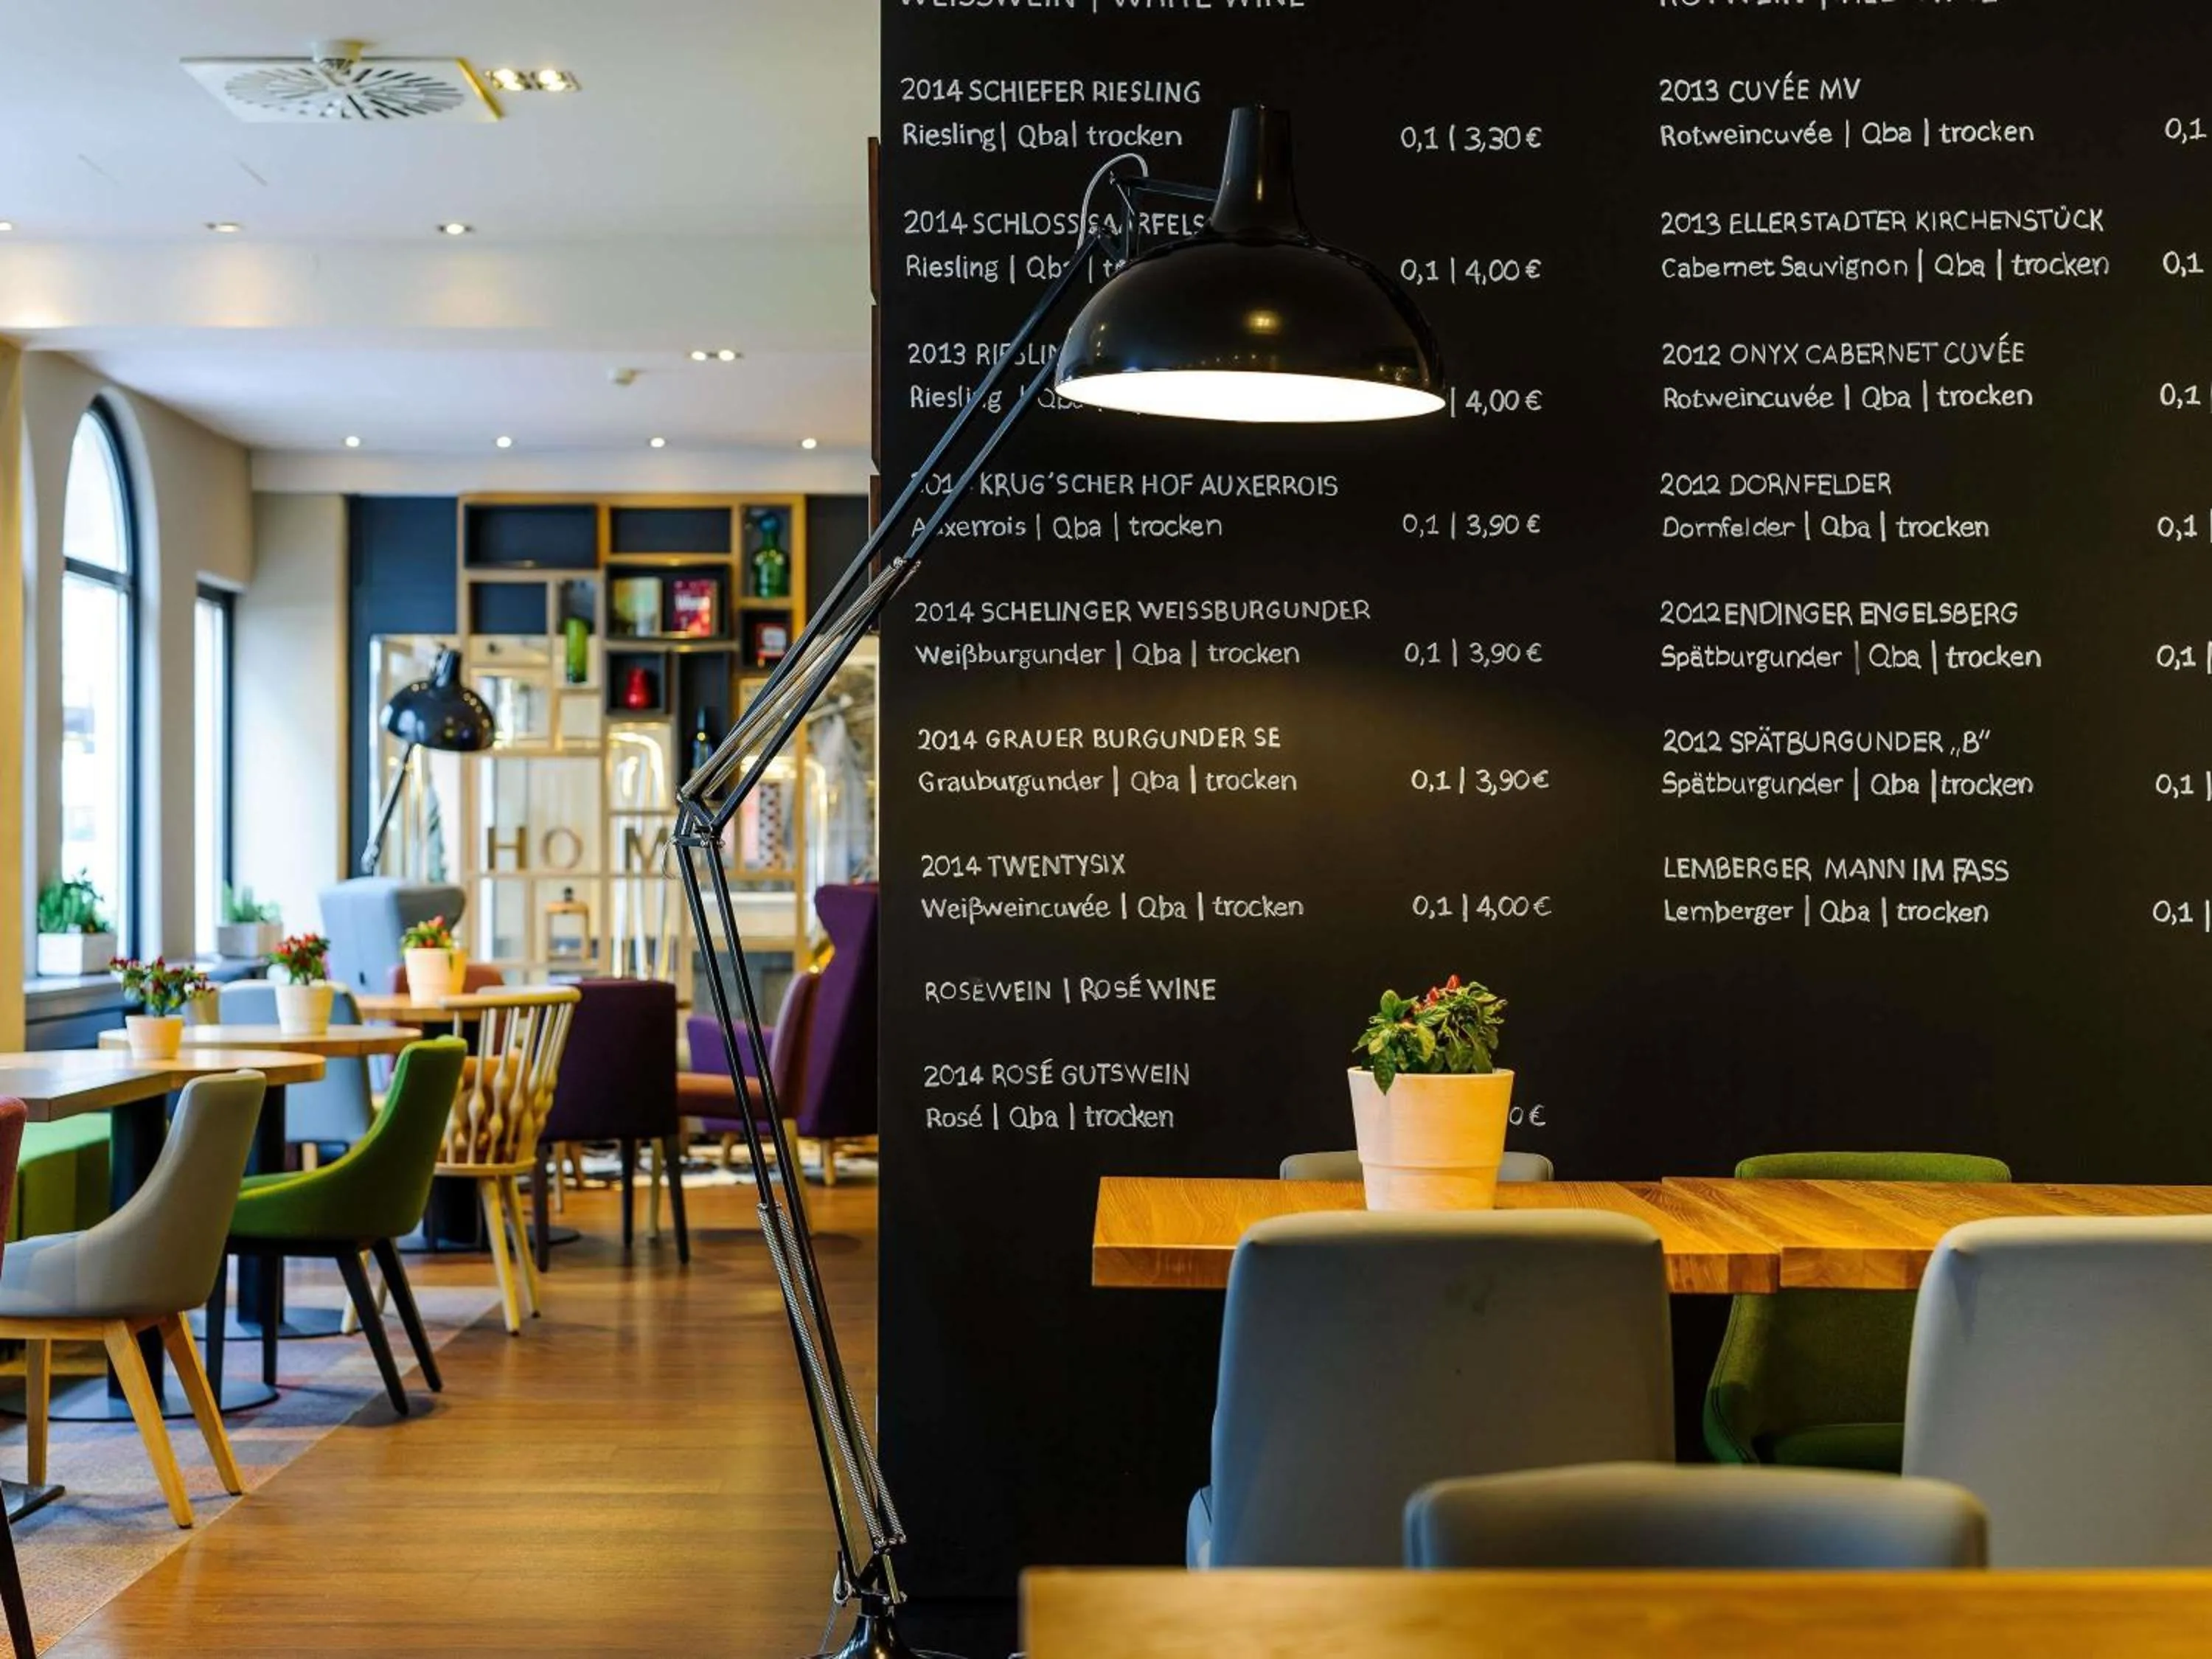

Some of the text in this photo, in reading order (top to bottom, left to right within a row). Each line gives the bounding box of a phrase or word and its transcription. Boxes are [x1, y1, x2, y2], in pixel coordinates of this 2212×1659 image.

[900, 77, 1200, 104] 2014 SCHIEFER RIESLING
[1659, 70, 1861, 103] 2013 CUVÉE MV
[1086, 123, 1183, 147] trocken
[1660, 119, 2034, 147] Rotweincuvée Qba trocken
[903, 209, 968, 235] 2014
[973, 212, 1080, 235] SCHLOSS
[1660, 204, 2104, 236] 2013 ELLERSTADTER KIRCHENSTÜCK
[906, 254, 998, 283] Riesling
[1026, 254, 1070, 280] Qb
[1661, 251, 2110, 281] Cabernet Sauvignon Qba trocken
[908, 342, 967, 366] 2013
[1662, 332, 2024, 366] 2012 ONYX CABERNET CUVÉE
[910, 384, 1003, 414] Rieslig
[1663, 383, 2033, 411] Rotweincuvée Qba trocken
[1142, 473, 1194, 496] HOF
[1200, 473, 1338, 498] AUXERROIS
[1660, 472, 1892, 496] 2012 DORNFELDER
[910, 514, 1222, 540] Axerrois Qba trocken
[1662, 514, 1989, 539] Dornfelder Qba trocken
[914, 599, 1371, 624] 2014 SCHELINGER WEISSBURGUNDER
[1660, 600, 2018, 627] 2012 ENDINGER ENGELSBERG
[914, 642, 1300, 671] Weißburgunder Qba trocken
[1660, 643, 2042, 673] Spätburgunder Qba trocken
[917, 726, 1281, 751] 2014 GRAUER BURGUNDER SE
[1663, 728, 1723, 754] 2012
[1729, 726, 1944, 756] SPÄTBURGUNDER
[918, 768, 1297, 798] Grauburgunder Qba trocken
[1661, 771, 2034, 800] Spätburgunder Qba trocken
[921, 853, 1126, 878] 2014 TWENTYSIX
[1664, 856, 2009, 884] LEMBERGER MANN IM FASS
[921, 893, 1304, 925] Weißweincuvée Qba trocken
[1664, 899, 1989, 925] Lemberger Qba trocken
[1079, 973, 1142, 1002] ROSÉ
[1146, 977, 1216, 1001] WINE
[924, 1058, 1189, 1088] 2014 ROSÉ GUTSWEIN
[926, 1103, 1174, 1130] Rosé Qba trocken
